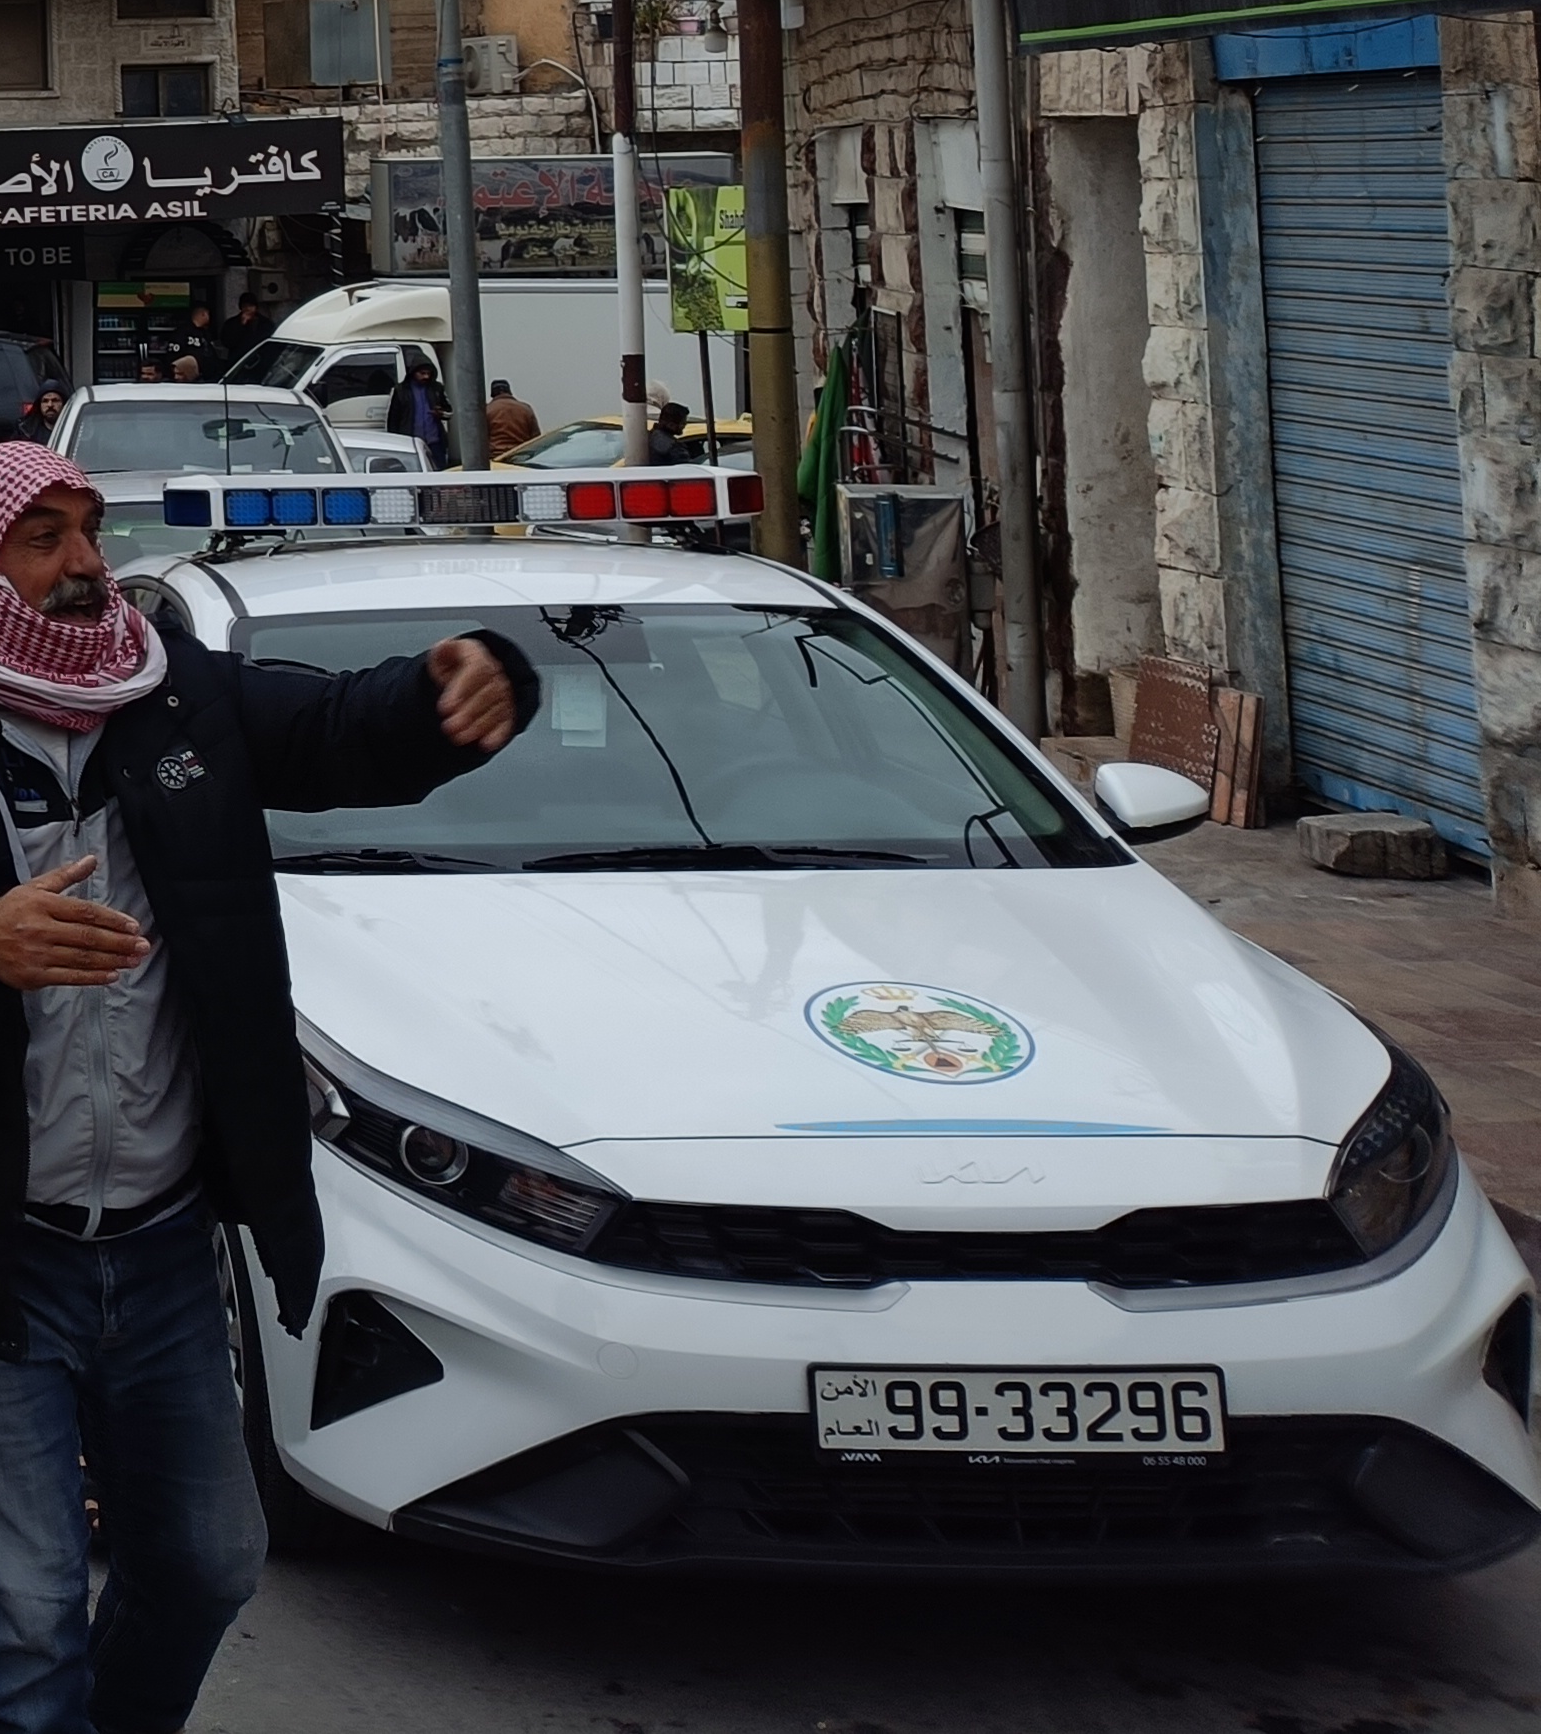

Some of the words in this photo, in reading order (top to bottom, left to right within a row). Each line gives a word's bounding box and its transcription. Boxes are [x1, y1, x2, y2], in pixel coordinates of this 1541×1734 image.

[101, 170, 115, 179] CA
[142, 145, 322, 196] كافتريا
[144, 200, 208, 220] ASIL
[4, 248, 36, 266] TO
[42, 246, 73, 265] BE
[819, 1376, 878, 1403] الأمن
[885, 1379, 1213, 1443] 99-33296
[823, 1418, 881, 1444] العام
[1142, 1455, 1157, 1466] 06
[1187, 1456, 1208, 1466] 000
